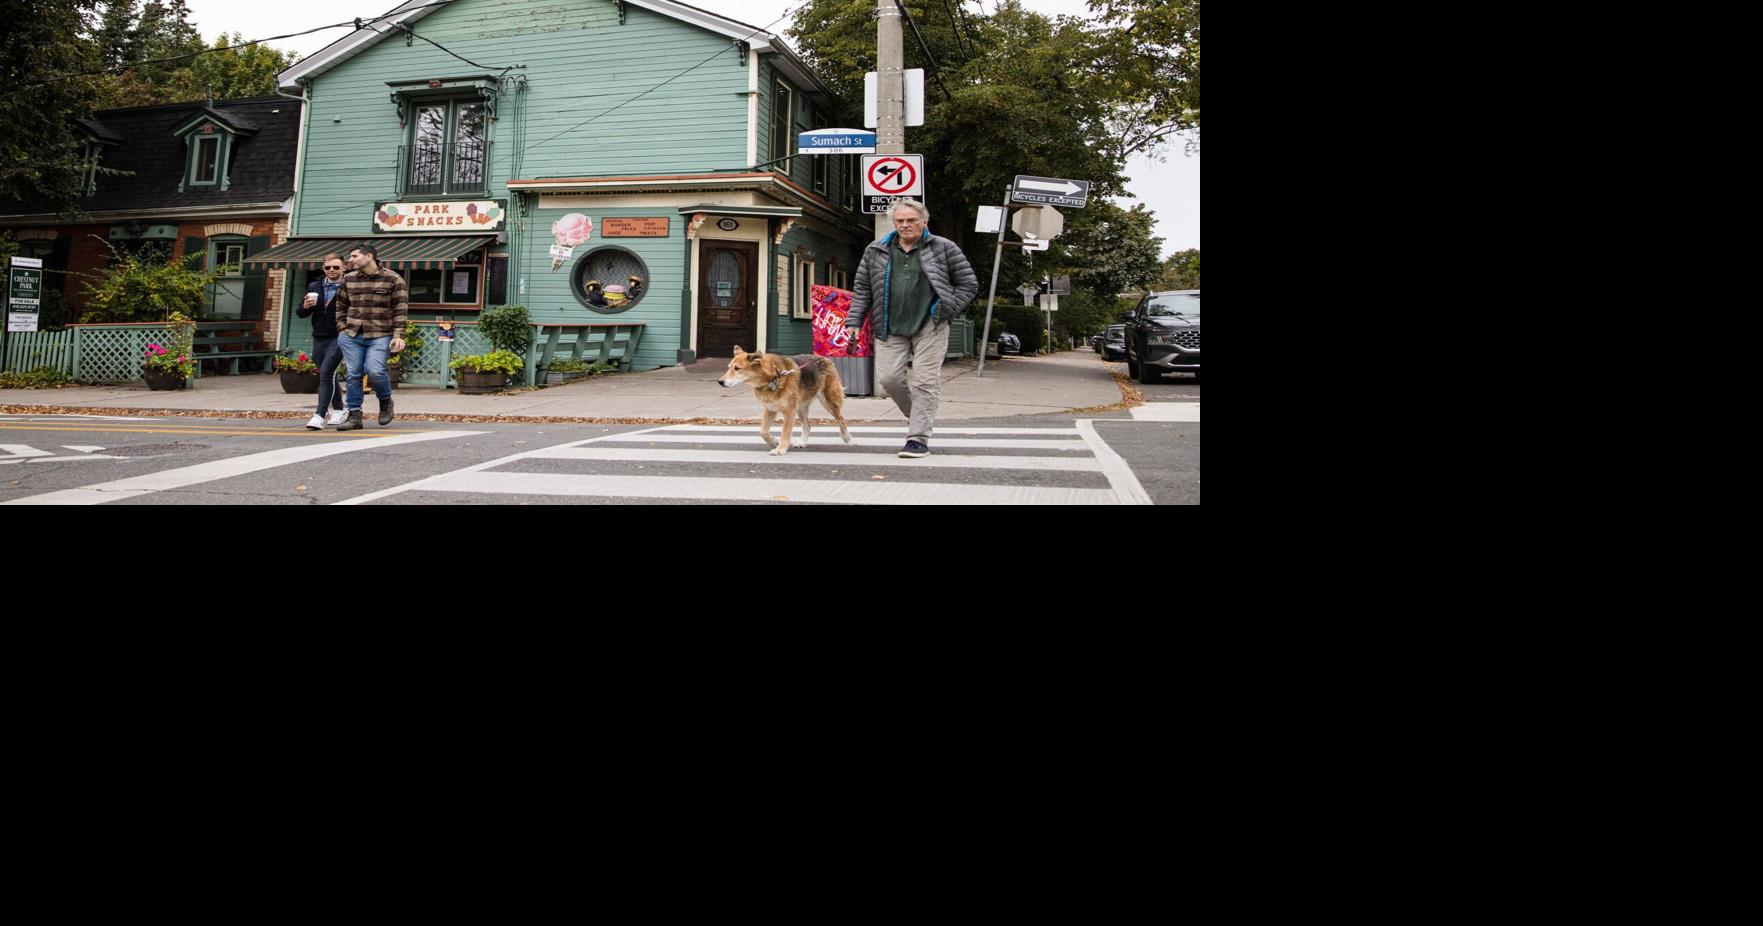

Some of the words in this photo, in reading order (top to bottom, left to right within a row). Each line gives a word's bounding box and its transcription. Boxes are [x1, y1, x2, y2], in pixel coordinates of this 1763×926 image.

[811, 136, 852, 146] Sumach
[854, 137, 862, 146] St
[871, 196, 913, 204] BICYC
[1014, 193, 1047, 202] BICYCLES
[1049, 197, 1085, 206] EXCEPTED
[414, 204, 450, 214] PARK
[870, 204, 891, 212] EXCE
[406, 216, 464, 227] SNACKS
[14, 276, 39, 284] CHESTNUT
